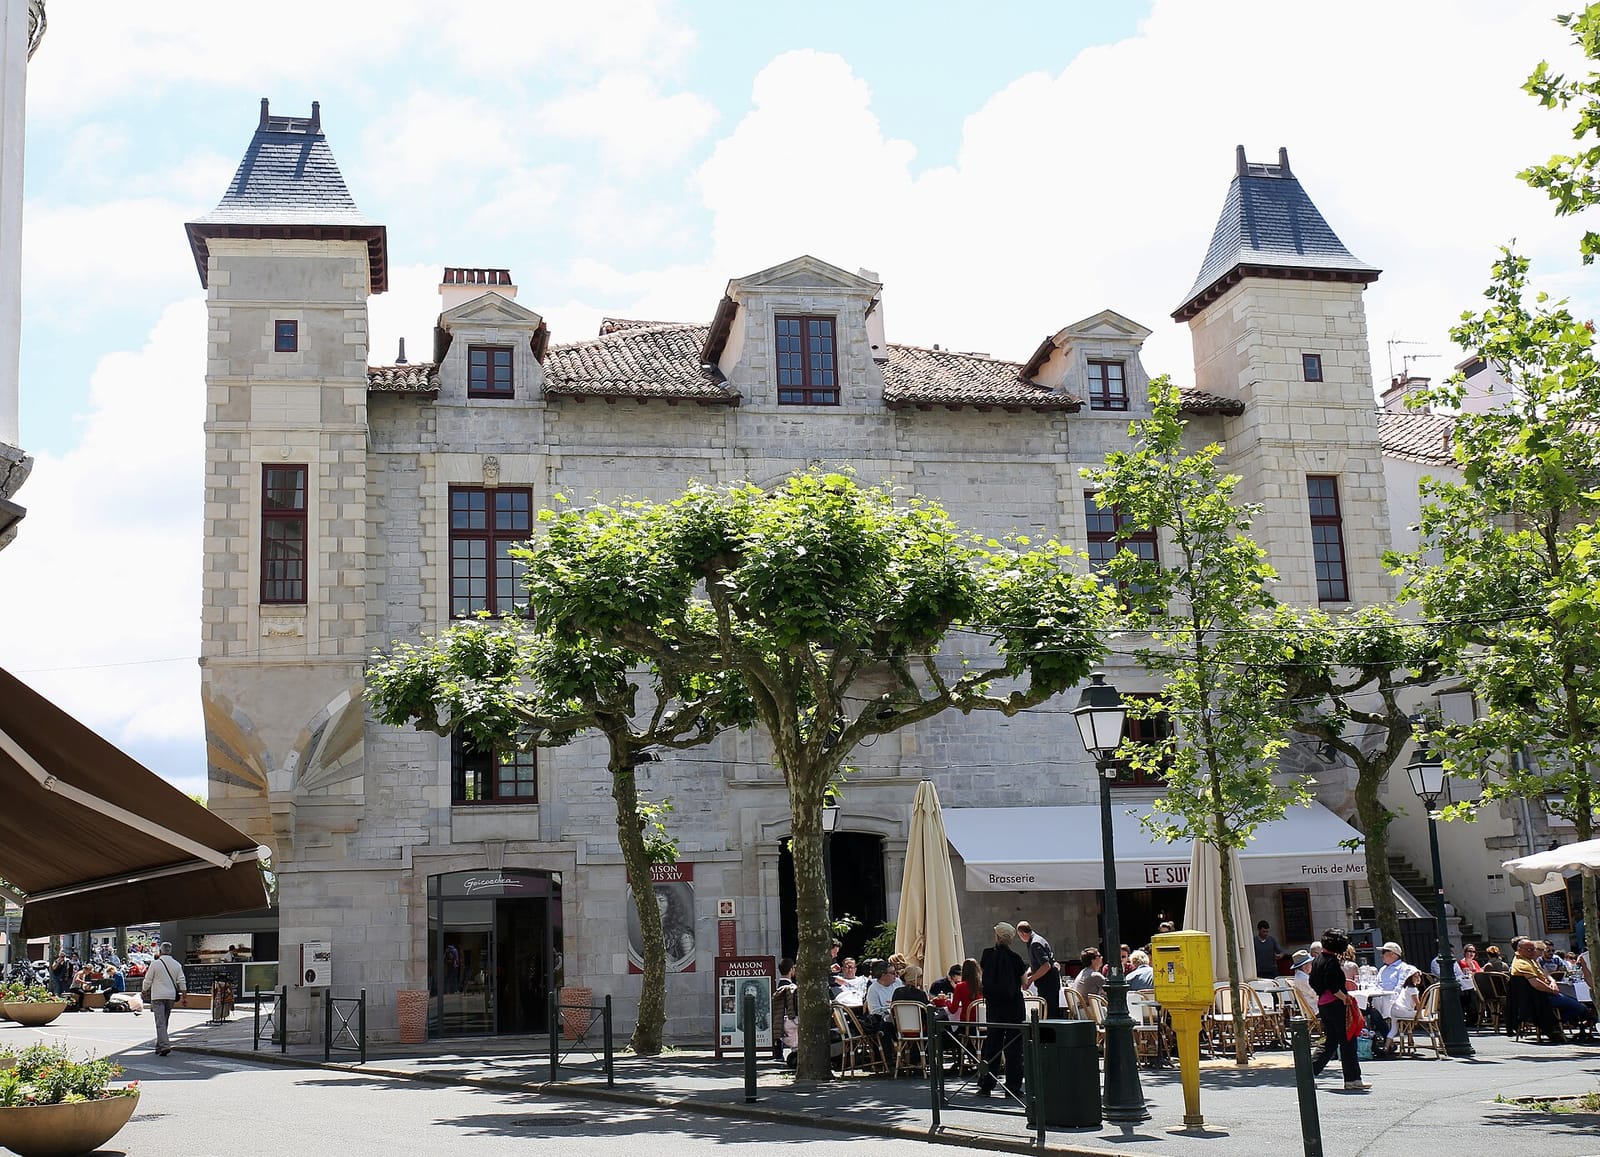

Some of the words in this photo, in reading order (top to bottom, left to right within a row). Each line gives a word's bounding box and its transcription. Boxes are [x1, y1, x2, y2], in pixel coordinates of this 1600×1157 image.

[650, 865, 678, 873] AISON
[1301, 864, 1329, 874] Fruits
[1331, 864, 1343, 873] de
[1345, 863, 1365, 873] Mer
[668, 872, 682, 880] XIV
[989, 873, 1035, 883] Brasserie
[1145, 868, 1160, 884] LE
[1166, 866, 1191, 883] SUI
[729, 961, 762, 969] MAISON
